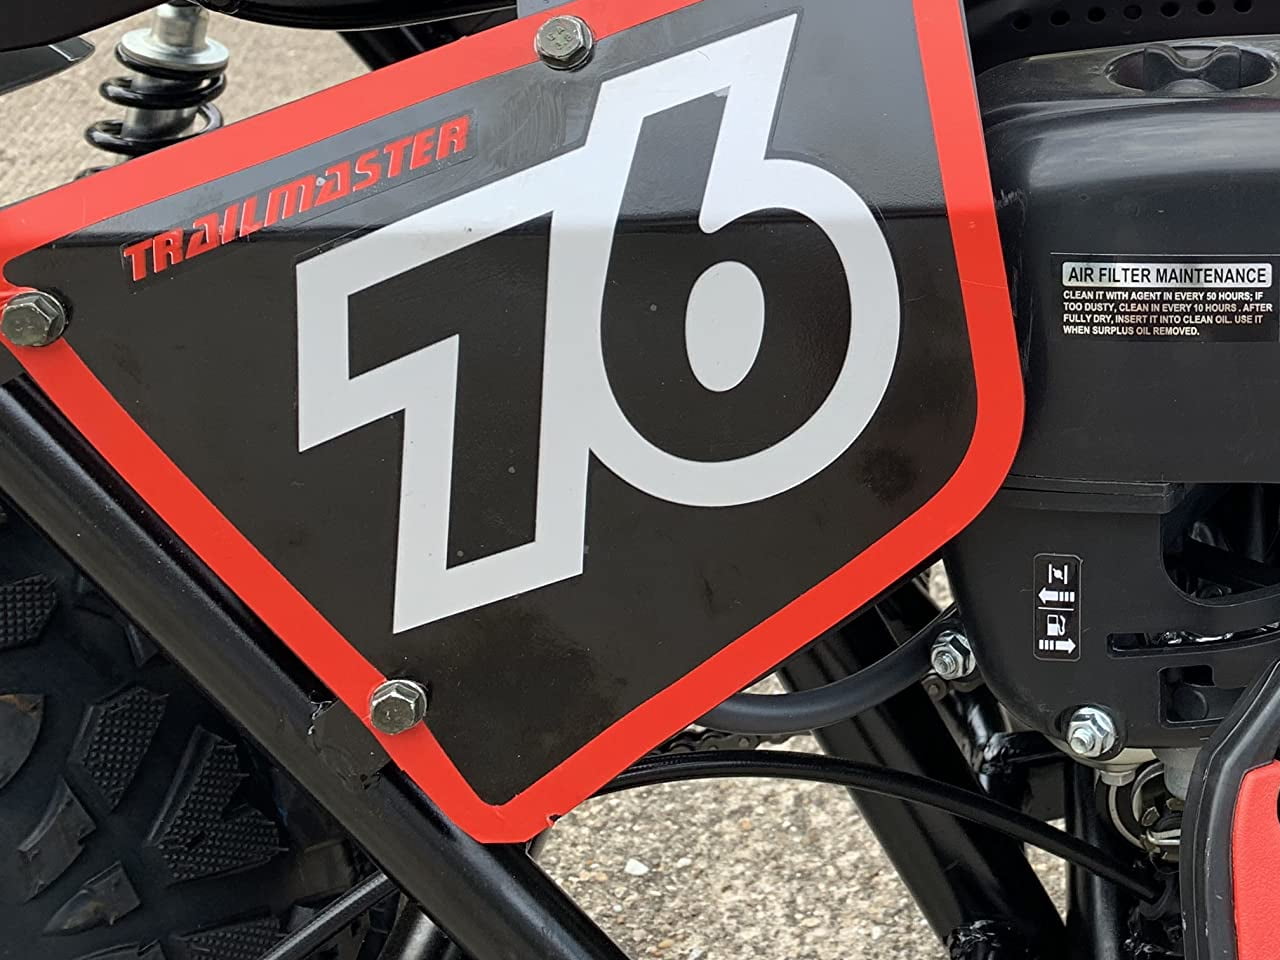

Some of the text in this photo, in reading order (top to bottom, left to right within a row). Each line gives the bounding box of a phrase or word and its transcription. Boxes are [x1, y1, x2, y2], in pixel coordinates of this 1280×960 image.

[123, 114, 471, 281] TRAILMASTER
[1068, 267, 1266, 284] AIR FILTER MAINTENANCE
[1063, 290, 1094, 300] CLEAN
[1096, 290, 1104, 300] IT
[1106, 290, 1128, 300] WITH
[1130, 290, 1162, 300] AGENT
[1163, 290, 1172, 300] IN
[1174, 291, 1204, 301] EVERY
[1206, 291, 1216, 301] 50
[1255, 291, 1264, 301] IF
[1063, 302, 1083, 312] TOO
[1084, 302, 1117, 313] DUSTY,
[1119, 302, 1149, 312] CLEAN
[1151, 302, 1158, 312] IN
[1162, 302, 1192, 312] EVERY
[1193, 303, 1204, 313] 10
[1242, 303, 1273, 313] AFTER
[1063, 314, 1092, 323] FULLY
[1093, 314, 1114, 324] DRY,
[1115, 314, 1148, 323] INSERT
[1149, 314, 1158, 323] IT
[1159, 314, 1181, 323] INTO
[1182, 315, 1213, 324] CLEAN
[1234, 315, 1253, 324] USE
[1254, 315, 1263, 324] IT
[1063, 325, 1200, 335] WHEN SURPLUS OIL REMOVED.
